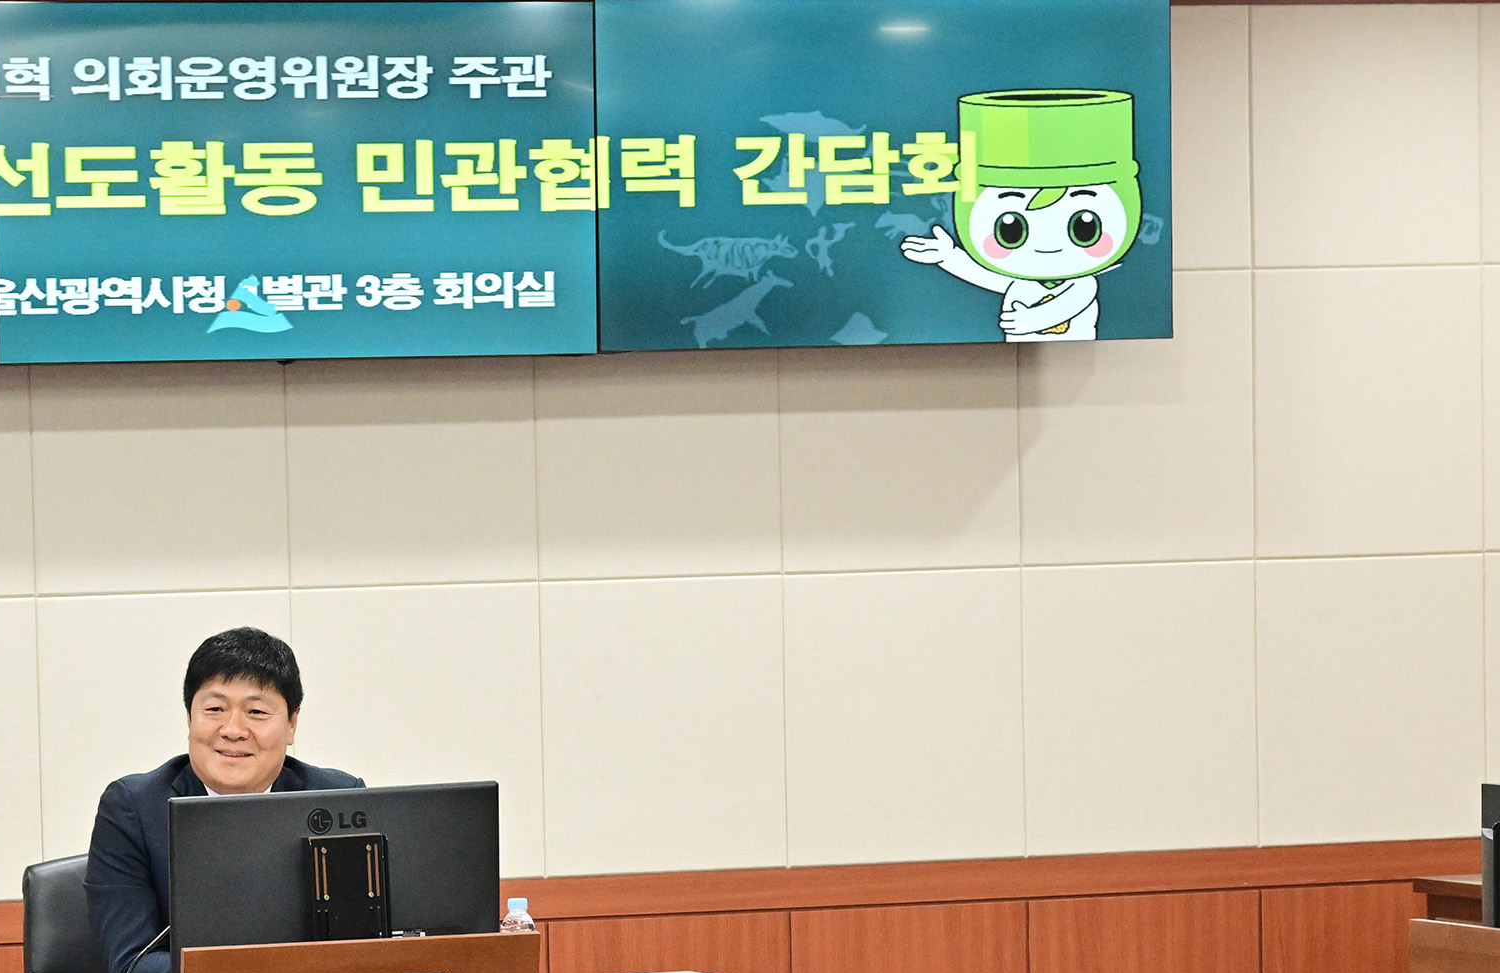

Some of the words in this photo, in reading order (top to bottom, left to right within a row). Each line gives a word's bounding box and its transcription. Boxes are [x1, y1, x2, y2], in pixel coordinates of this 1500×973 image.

[70, 55, 433, 101] 의회운영위원장
[449, 54, 552, 99] 주관
[356, 134, 696, 213] 민관협력
[732, 131, 976, 206] 간담회
[240, 273, 348, 311] 별관
[355, 273, 424, 311] 3층
[433, 271, 556, 310] 회의실
[338, 810, 368, 829] LG
